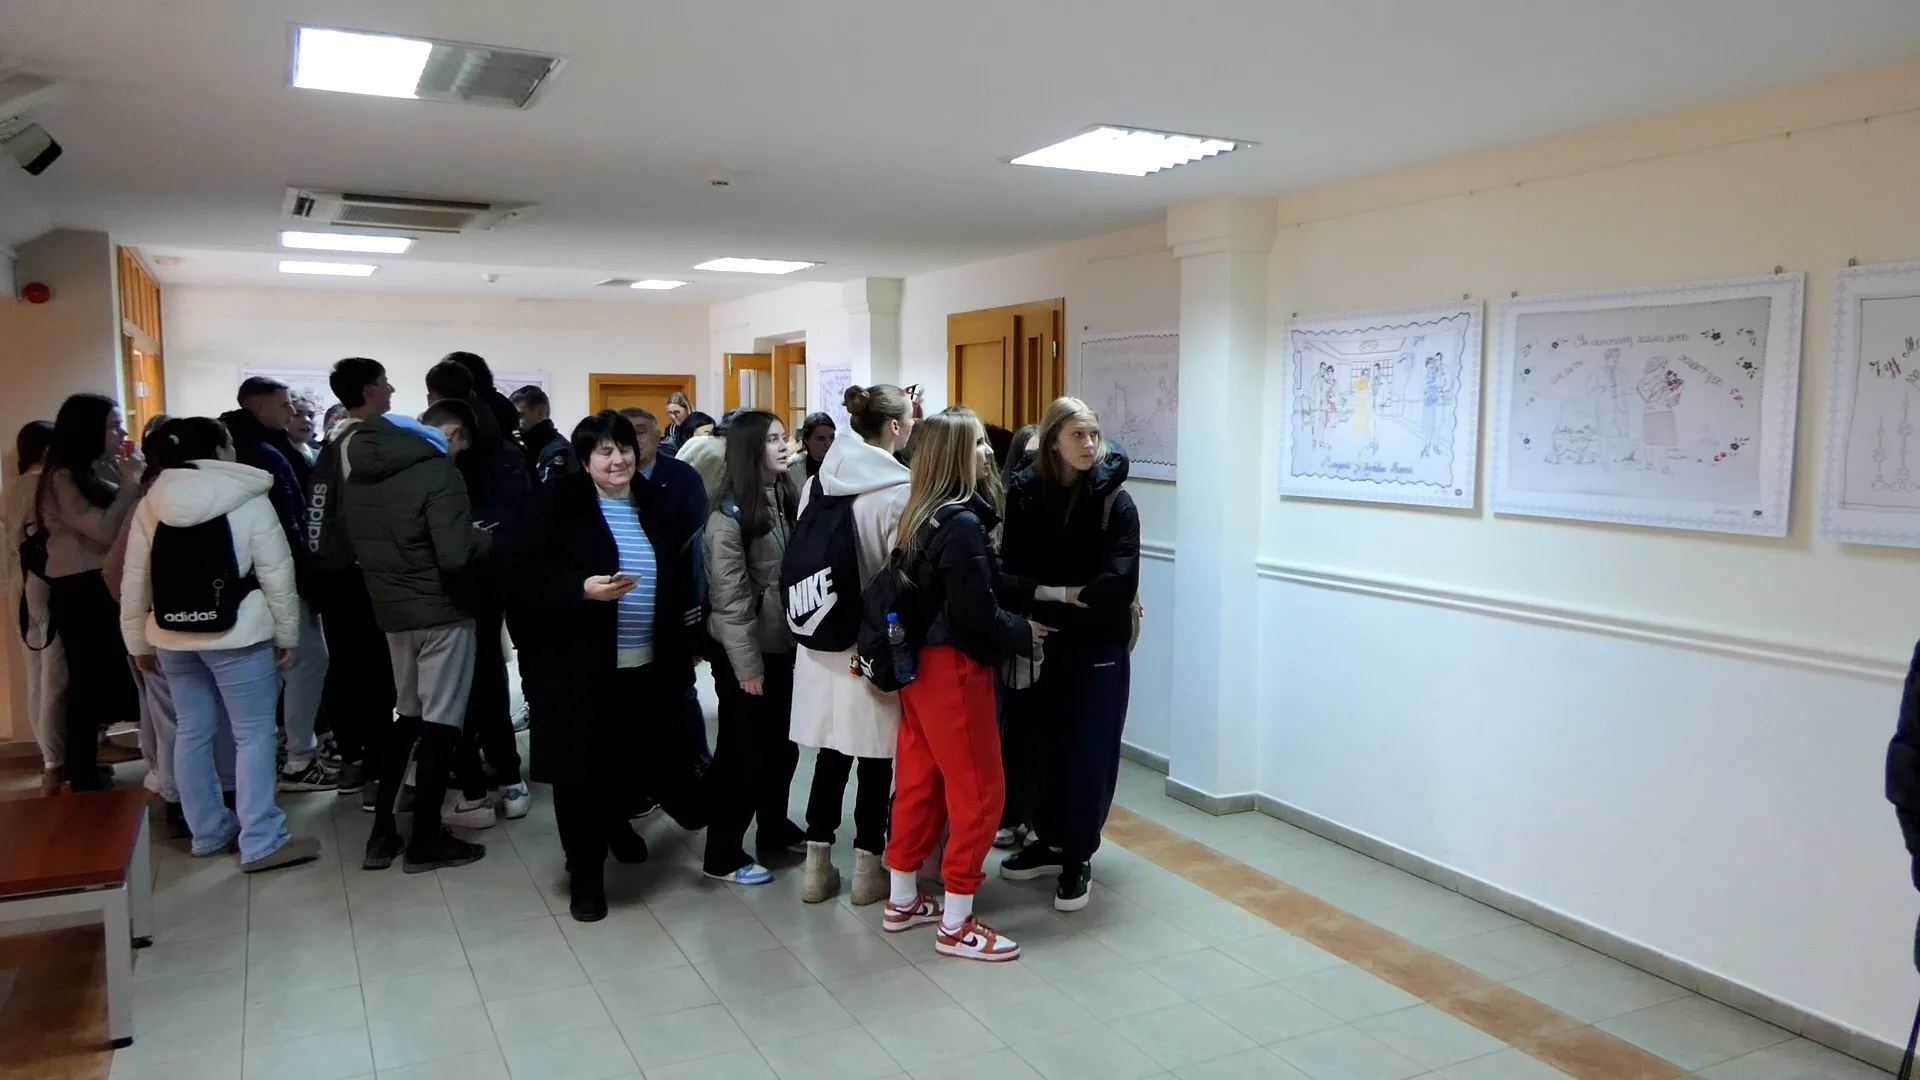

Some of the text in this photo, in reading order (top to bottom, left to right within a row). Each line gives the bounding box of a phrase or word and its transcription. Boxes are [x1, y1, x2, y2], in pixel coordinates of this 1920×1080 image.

[307, 483, 328, 553] adidas
[164, 610, 218, 623] adidas
[788, 566, 837, 620] NIKE
